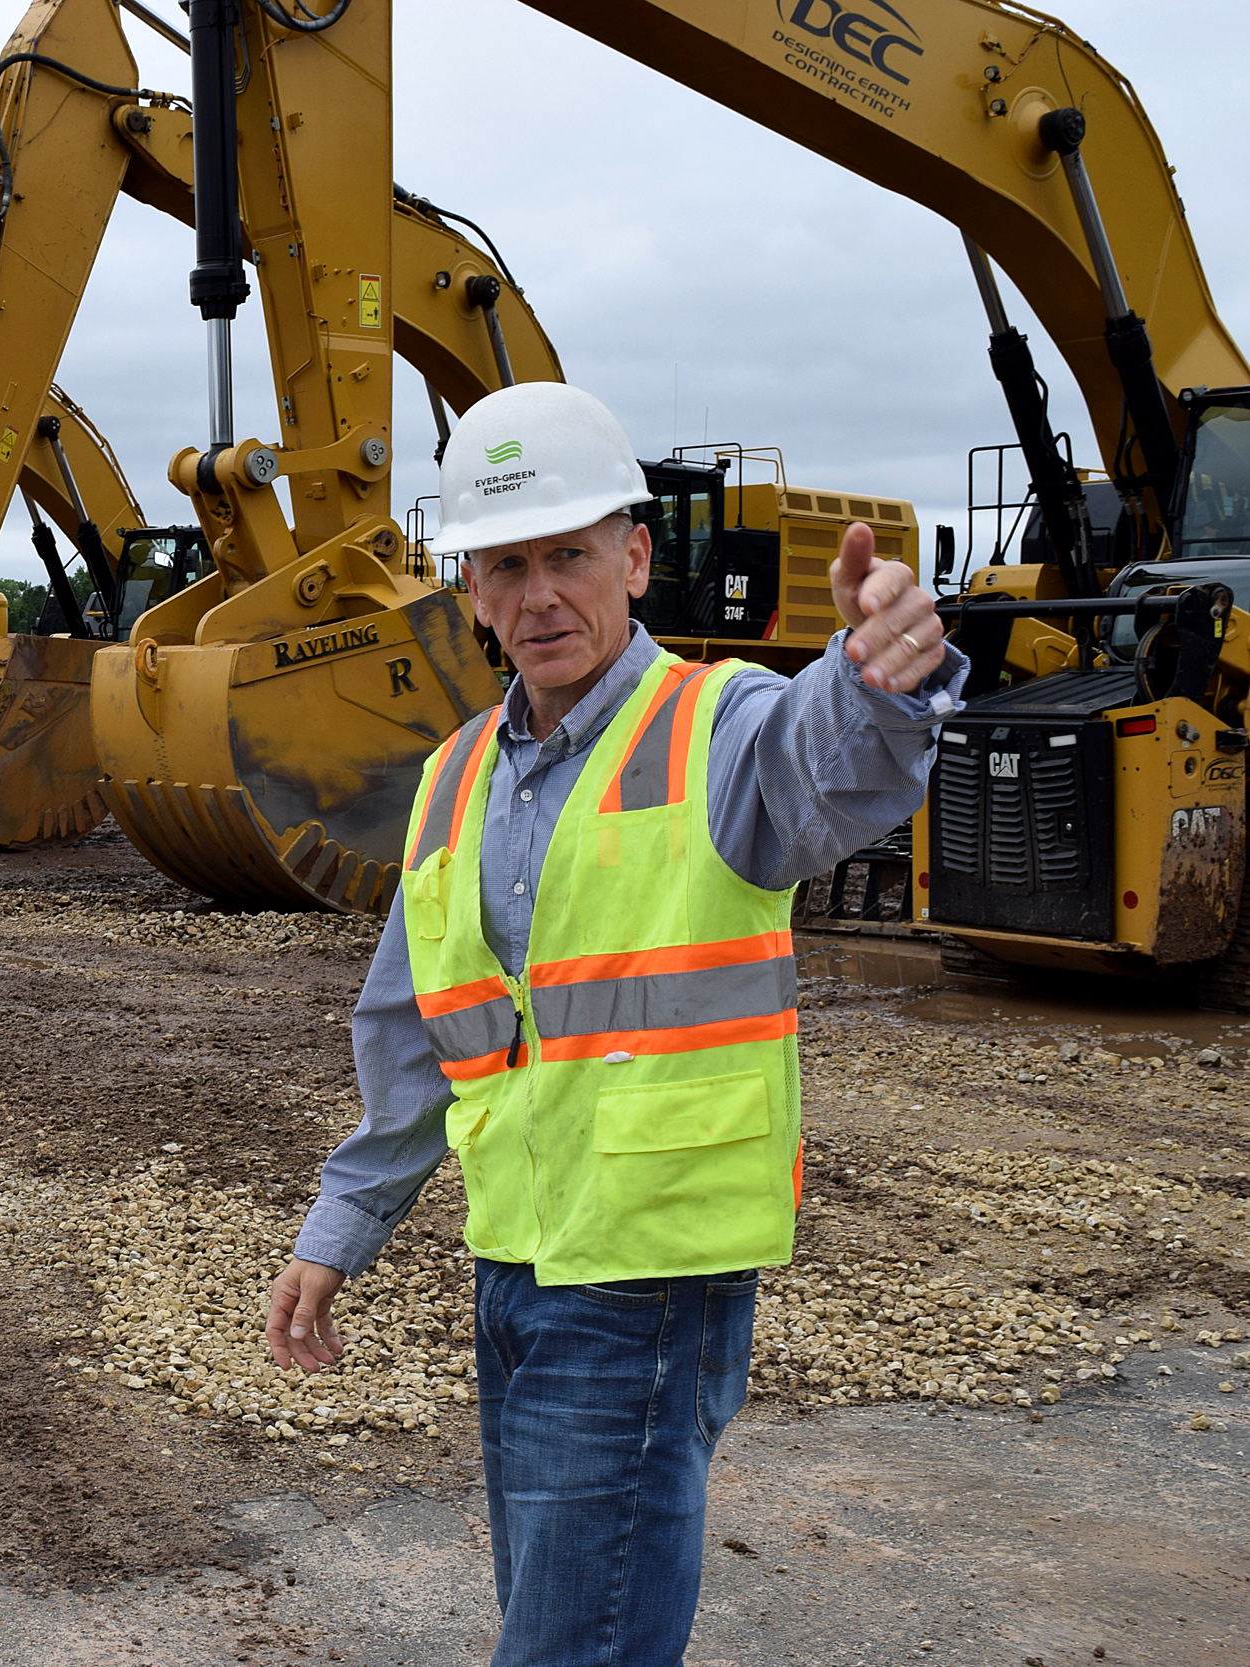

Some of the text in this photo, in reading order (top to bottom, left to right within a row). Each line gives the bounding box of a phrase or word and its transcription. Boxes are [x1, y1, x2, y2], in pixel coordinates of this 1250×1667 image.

[789, 0, 924, 86] DEC
[772, 30, 911, 111] DESIGNING EARTH
[784, 53, 895, 118] CONTRACTING
[475, 469, 536, 488] EVER-GREEN
[483, 481, 522, 496] ENERGY
[725, 574, 749, 599] CAT
[724, 605, 745, 620] 374F
[273, 622, 379, 668] RAVELING
[385, 656, 419, 697] R
[989, 751, 1020, 778] CAT
